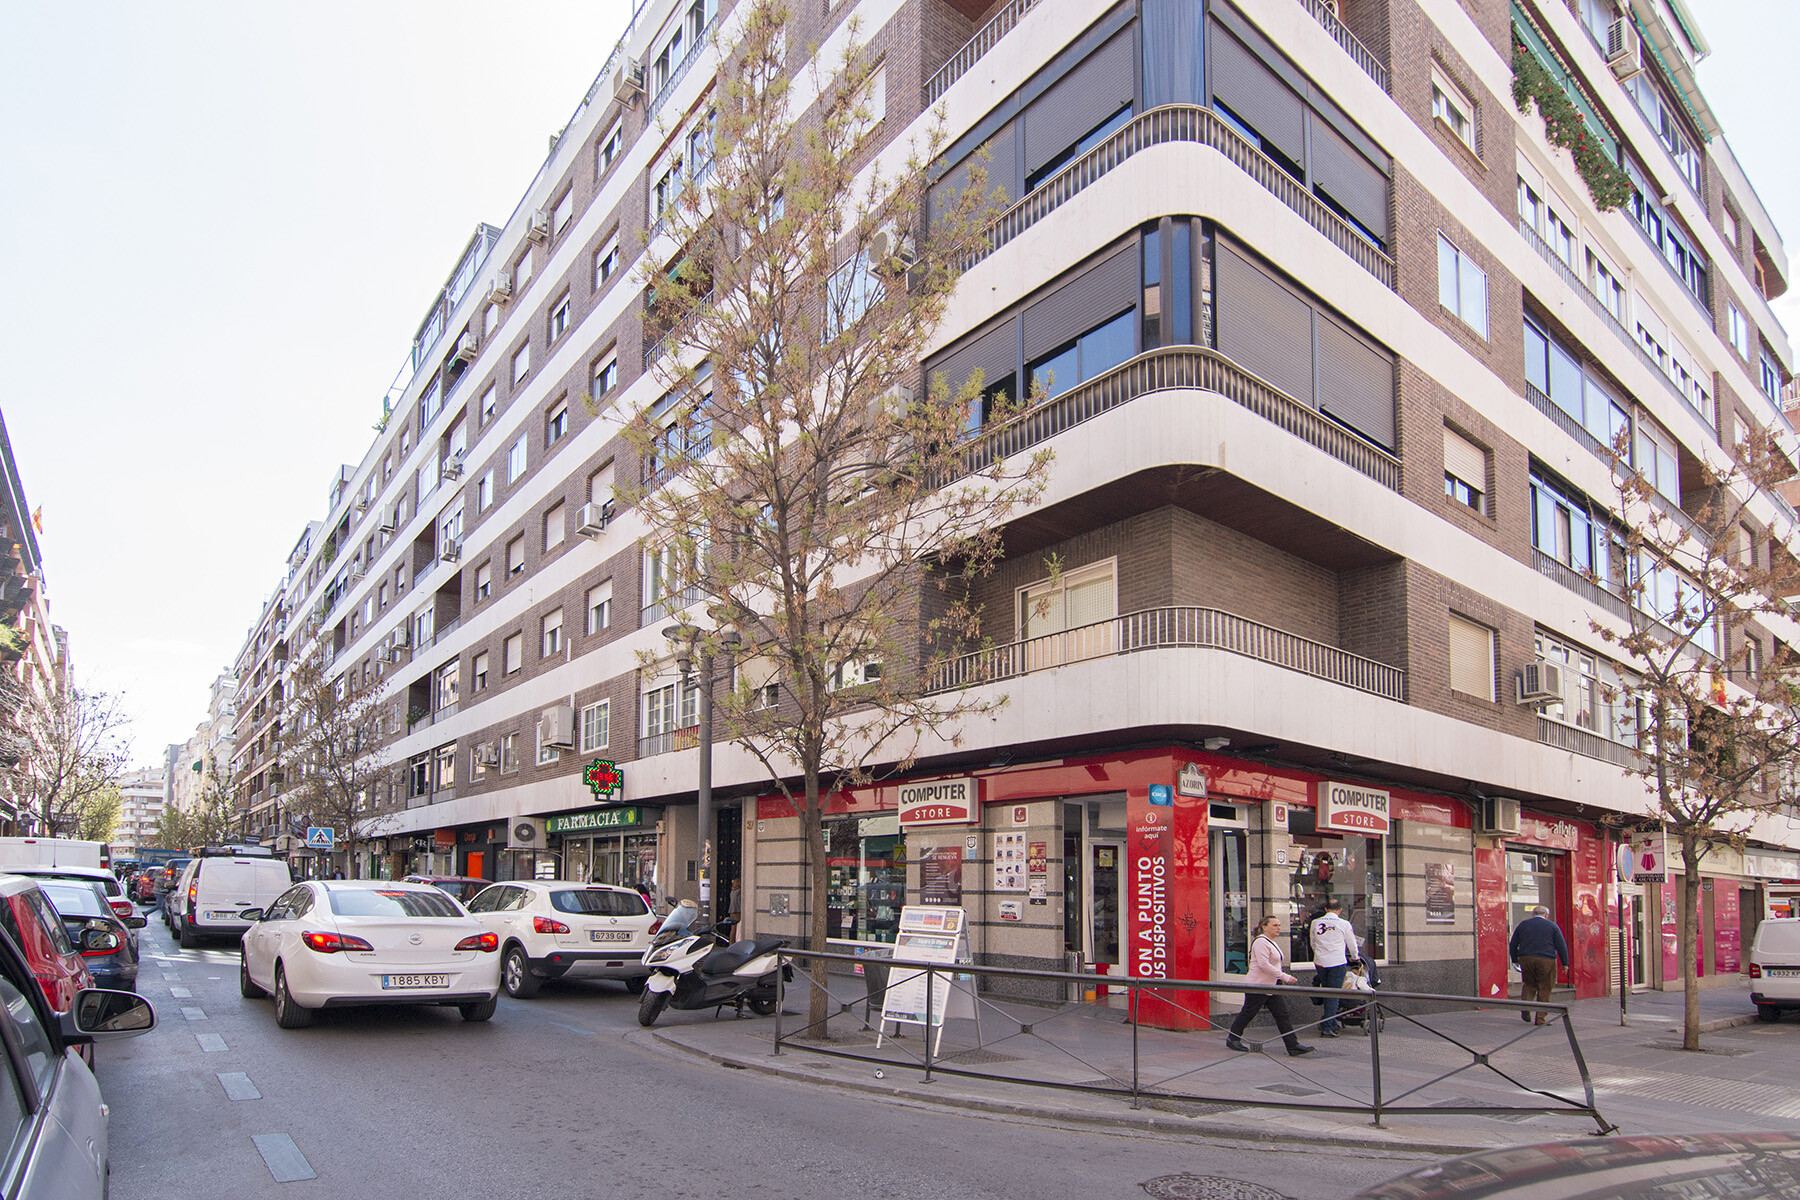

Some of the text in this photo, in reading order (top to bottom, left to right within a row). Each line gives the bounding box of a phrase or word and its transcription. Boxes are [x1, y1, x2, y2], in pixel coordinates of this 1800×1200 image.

[901, 783, 966, 804] COMPUTER
[1331, 787, 1387, 812] COMPUTER
[915, 807, 951, 820] STORE
[1343, 813, 1375, 827] STORE
[557, 811, 619, 830] FARMACIA
[1135, 825, 1168, 833] infórmate
[1144, 832, 1160, 840] aquí
[1152, 856, 1167, 959] DISPOSITIVOS
[1137, 856, 1154, 977] ON A PUNTO
[595, 932, 615, 940] 6739
[1772, 969, 1790, 977] 4932
[392, 975, 446, 986] 1885 KBY
